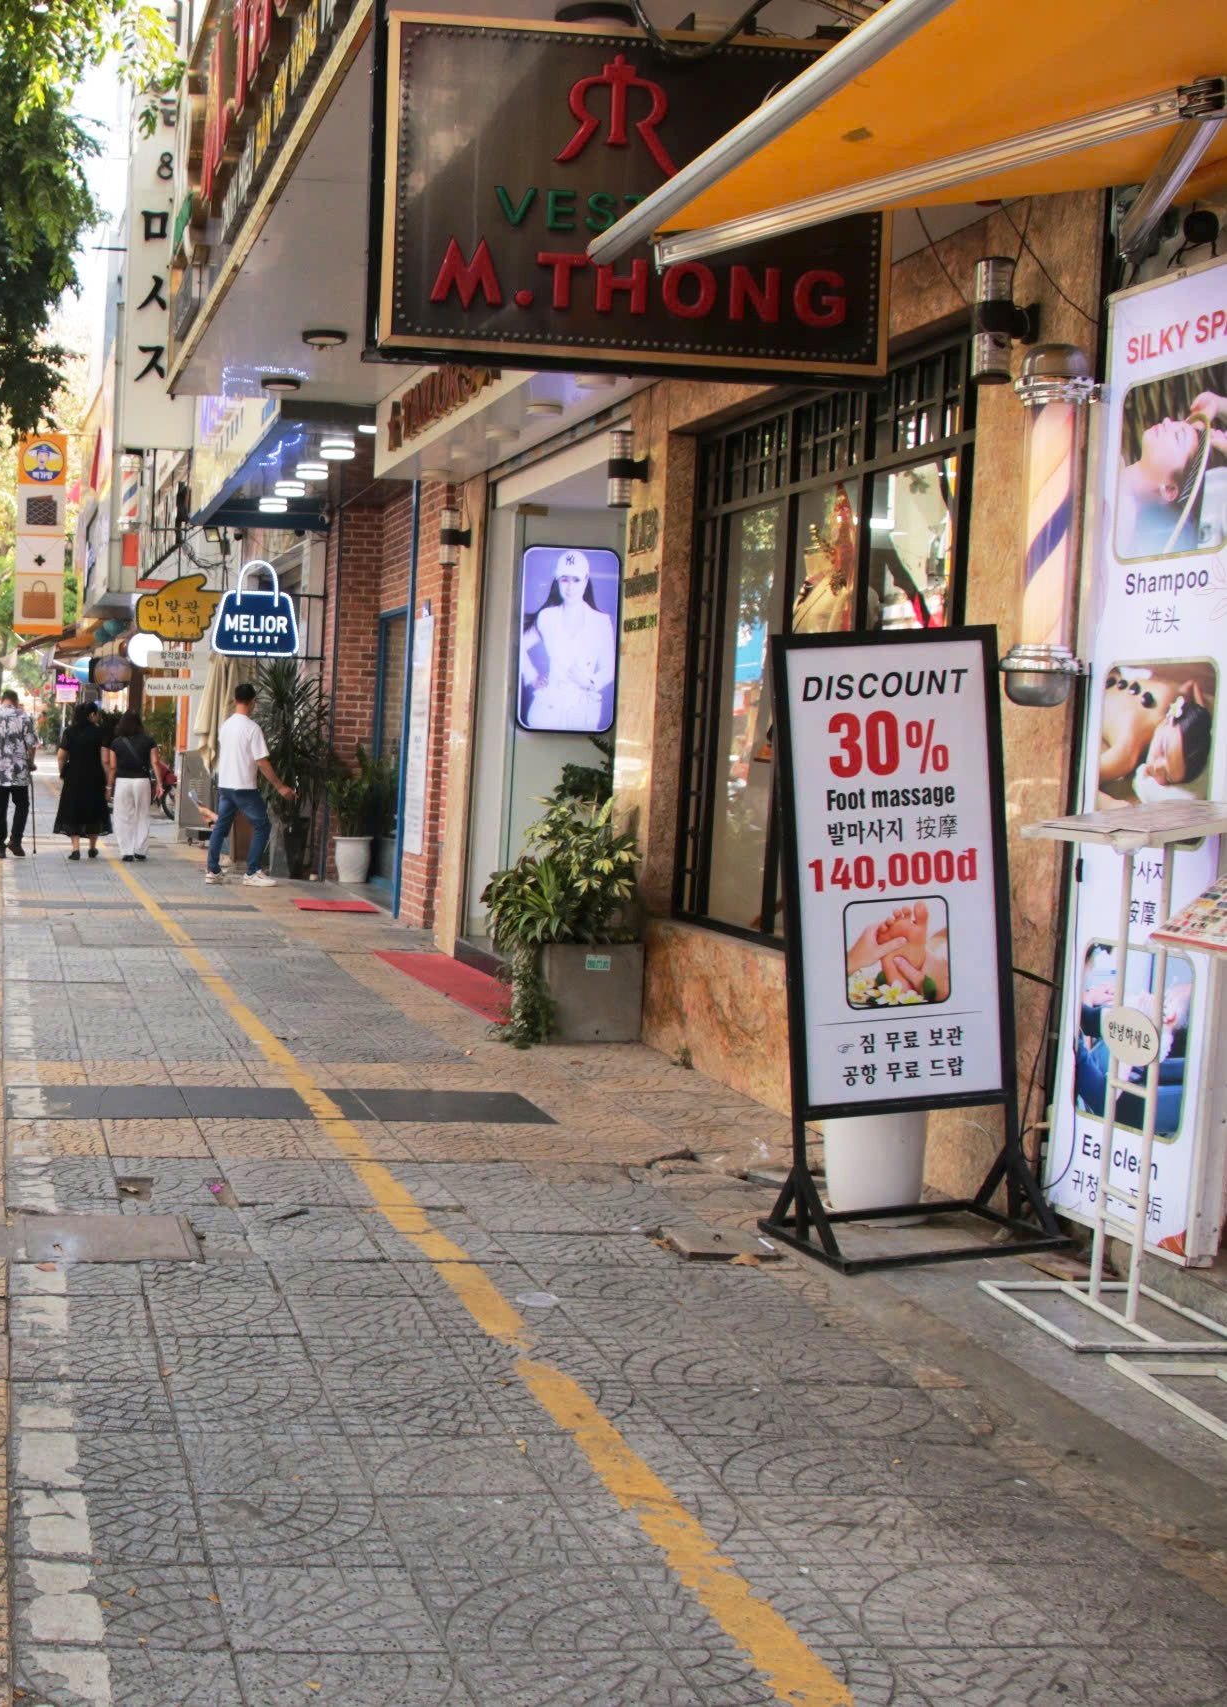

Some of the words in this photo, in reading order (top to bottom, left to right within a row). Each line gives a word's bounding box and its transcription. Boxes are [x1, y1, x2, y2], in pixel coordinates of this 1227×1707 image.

[430, 235, 847, 328] M.THONG
[1127, 321, 1189, 364] SILKY
[1195, 310, 1227, 343] SP
[1125, 570, 1209, 596] Shampoo
[225, 613, 288, 633] MELIOR
[1145, 605, 1181, 634] 洗头
[233, 635, 279, 644] LUXURY
[802, 668, 969, 702] DISCOUNT
[828, 710, 950, 778] 30%
[827, 788, 866, 811] Foot
[871, 785, 955, 808] massage
[827, 817, 904, 846] 발마사지
[916, 814, 959, 840] 按摩
[808, 847, 978, 893] 140,000đ
[860, 1034, 875, 1054] 짐
[885, 1031, 920, 1053] 무료
[929, 1026, 963, 1048] 보관
[1108, 1021, 1151, 1050] 안녕하세요
[842, 1064, 878, 1087] 공항
[886, 1061, 921, 1082] 무료
[929, 1056, 964, 1077] 드랍
[1082, 1133, 1101, 1160] Ea
[1113, 1148, 1158, 1181] clen
[1072, 1169, 1112, 1203] 귀청
